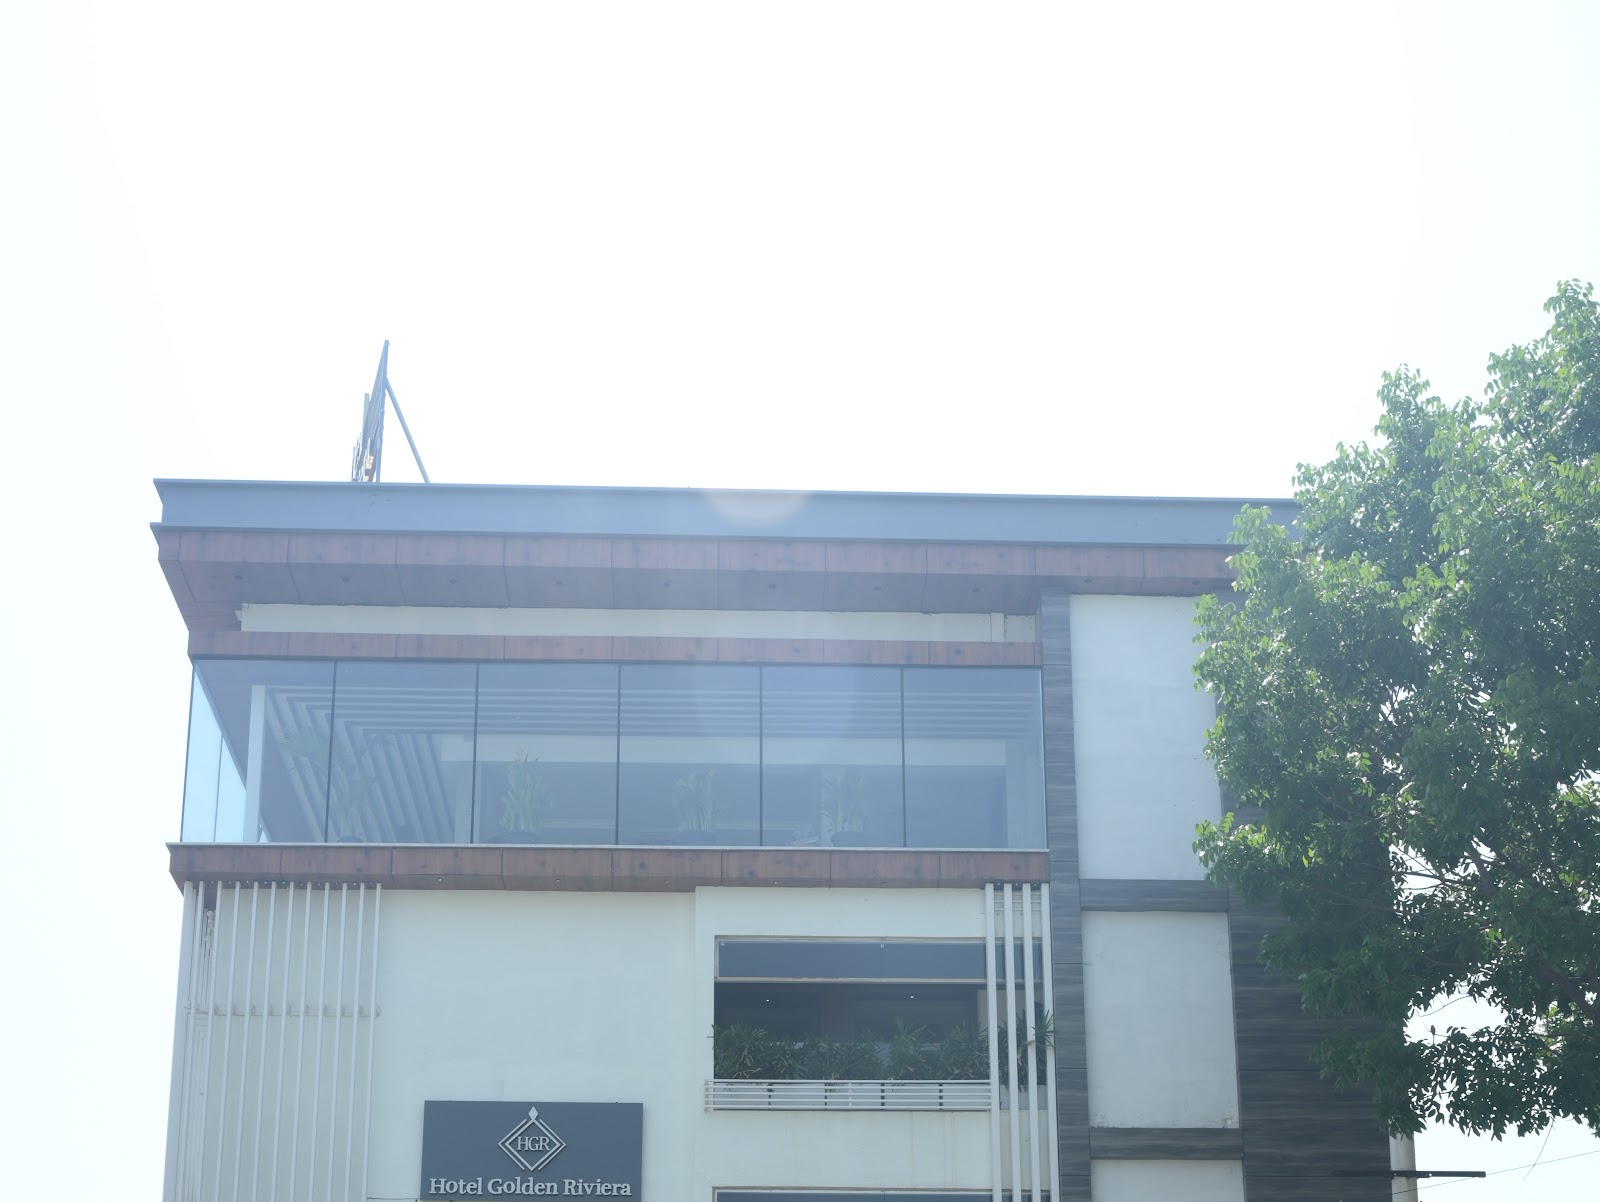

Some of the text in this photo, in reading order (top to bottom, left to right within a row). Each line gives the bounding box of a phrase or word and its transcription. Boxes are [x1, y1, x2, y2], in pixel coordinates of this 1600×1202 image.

[517, 1136, 550, 1151] HGR
[429, 1176, 632, 1196] Hotel Golden Riviera
